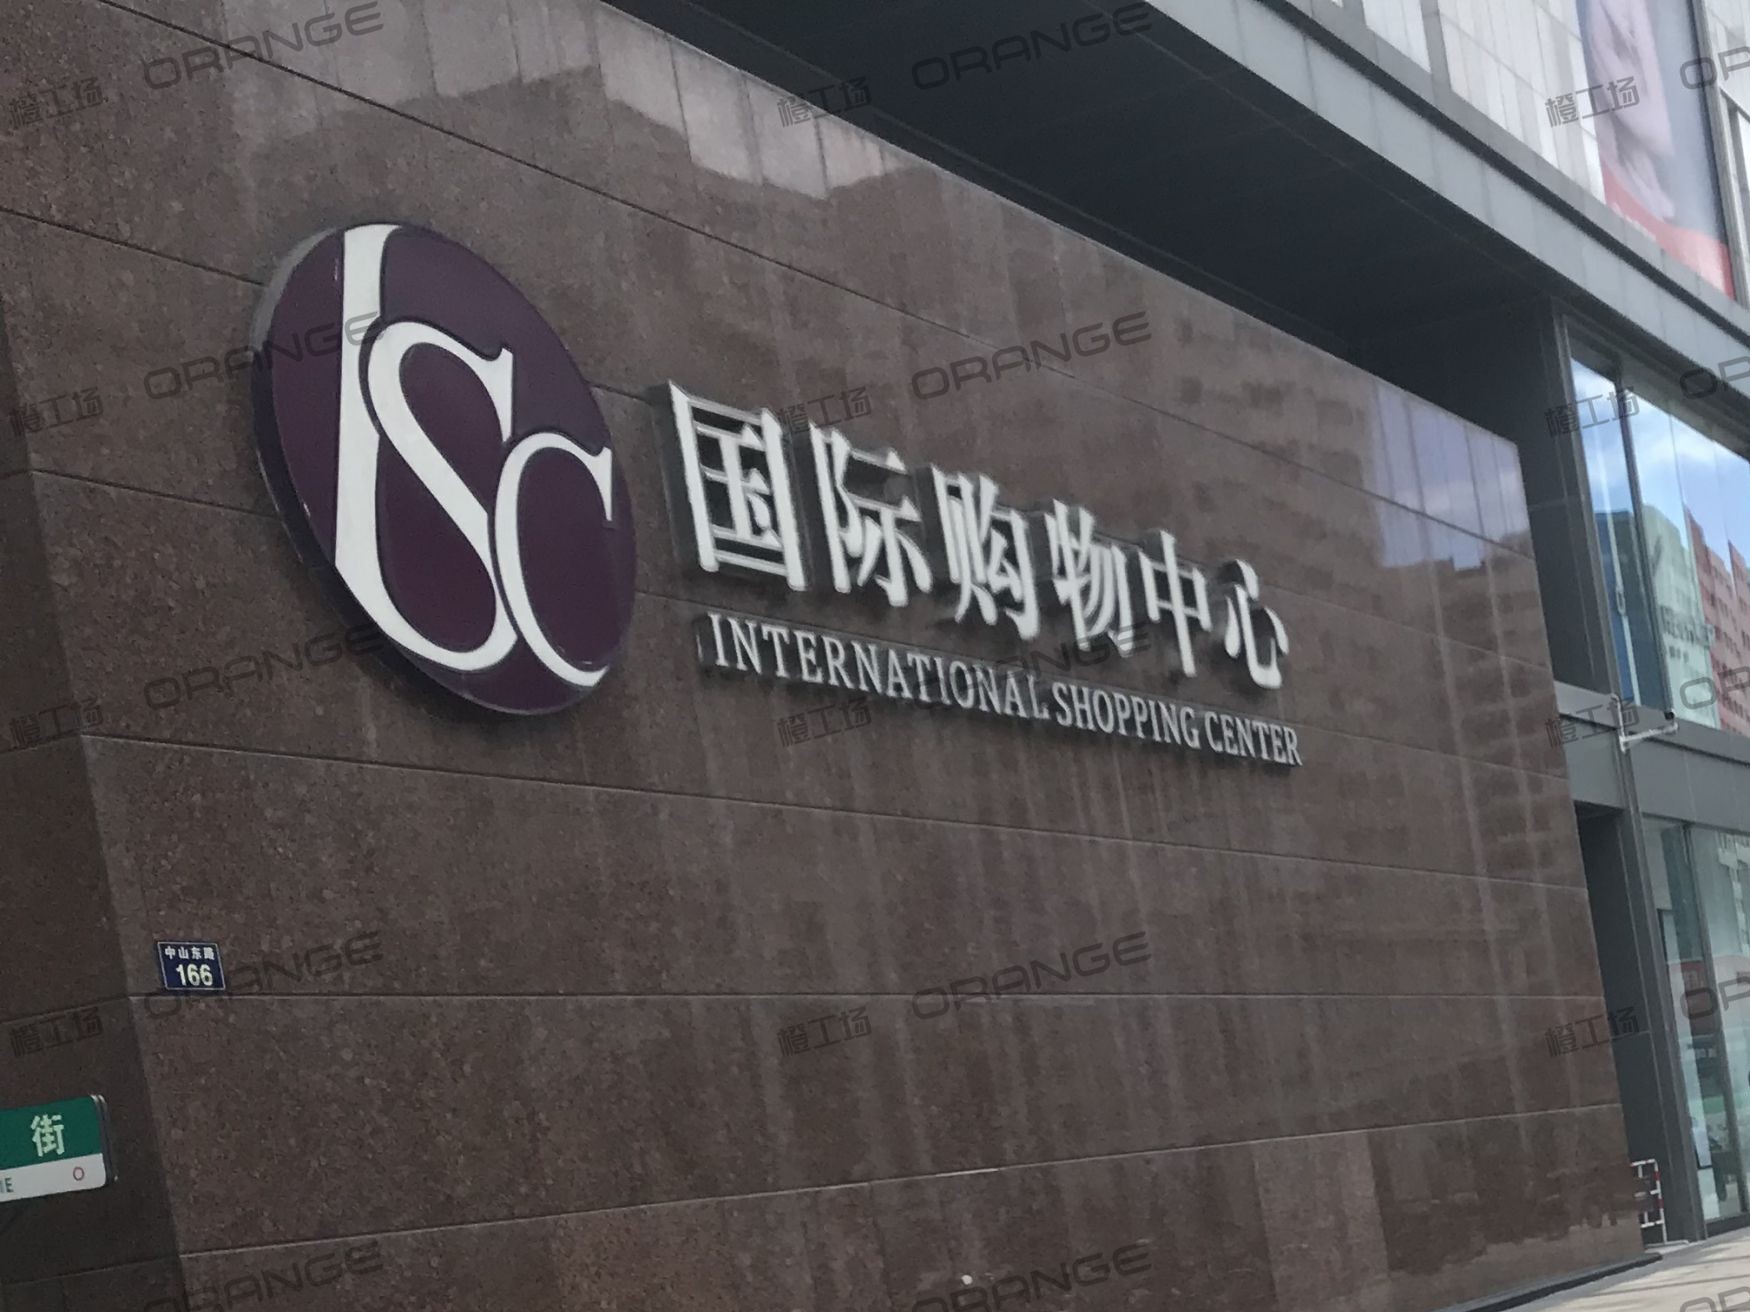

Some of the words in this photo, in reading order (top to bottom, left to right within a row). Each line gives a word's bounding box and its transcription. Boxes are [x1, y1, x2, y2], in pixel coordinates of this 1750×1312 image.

[669, 381, 1289, 689] 国际购物中心
[709, 613, 1049, 718] INTERNATIONAL
[1052, 683, 1199, 750] SHOPPING
[1204, 714, 1302, 766] CENTER
[164, 945, 215, 960] 中山东路
[176, 963, 213, 986] 166
[30, 1114, 65, 1157] 街
